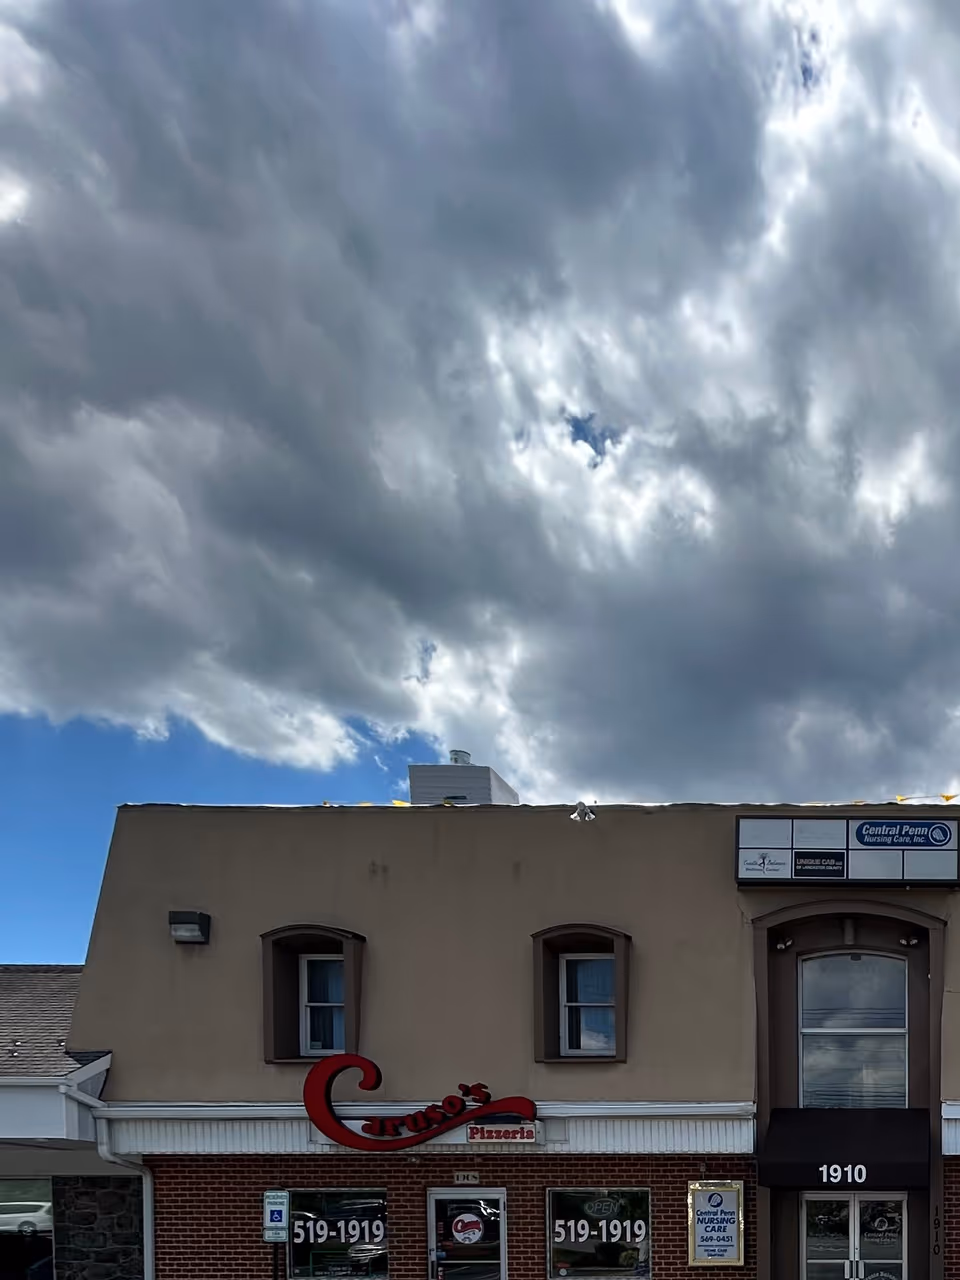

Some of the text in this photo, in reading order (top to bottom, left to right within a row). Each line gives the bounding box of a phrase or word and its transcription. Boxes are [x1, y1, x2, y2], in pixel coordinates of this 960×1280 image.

[862, 825, 928, 835] Central Penn
[864, 835, 892, 844] Nursing
[303, 1054, 537, 1152] Caruso's
[469, 1126, 534, 1140] Pizzeria
[819, 1164, 867, 1183] 1910
[585, 1201, 618, 1215] OPEN
[697, 1217, 736, 1225] NURSING
[294, 1219, 386, 1244] 519-1919
[554, 1219, 646, 1243] 519-1919
[704, 1225, 728, 1233] CARE
[932, 1205, 941, 1255] 1910
